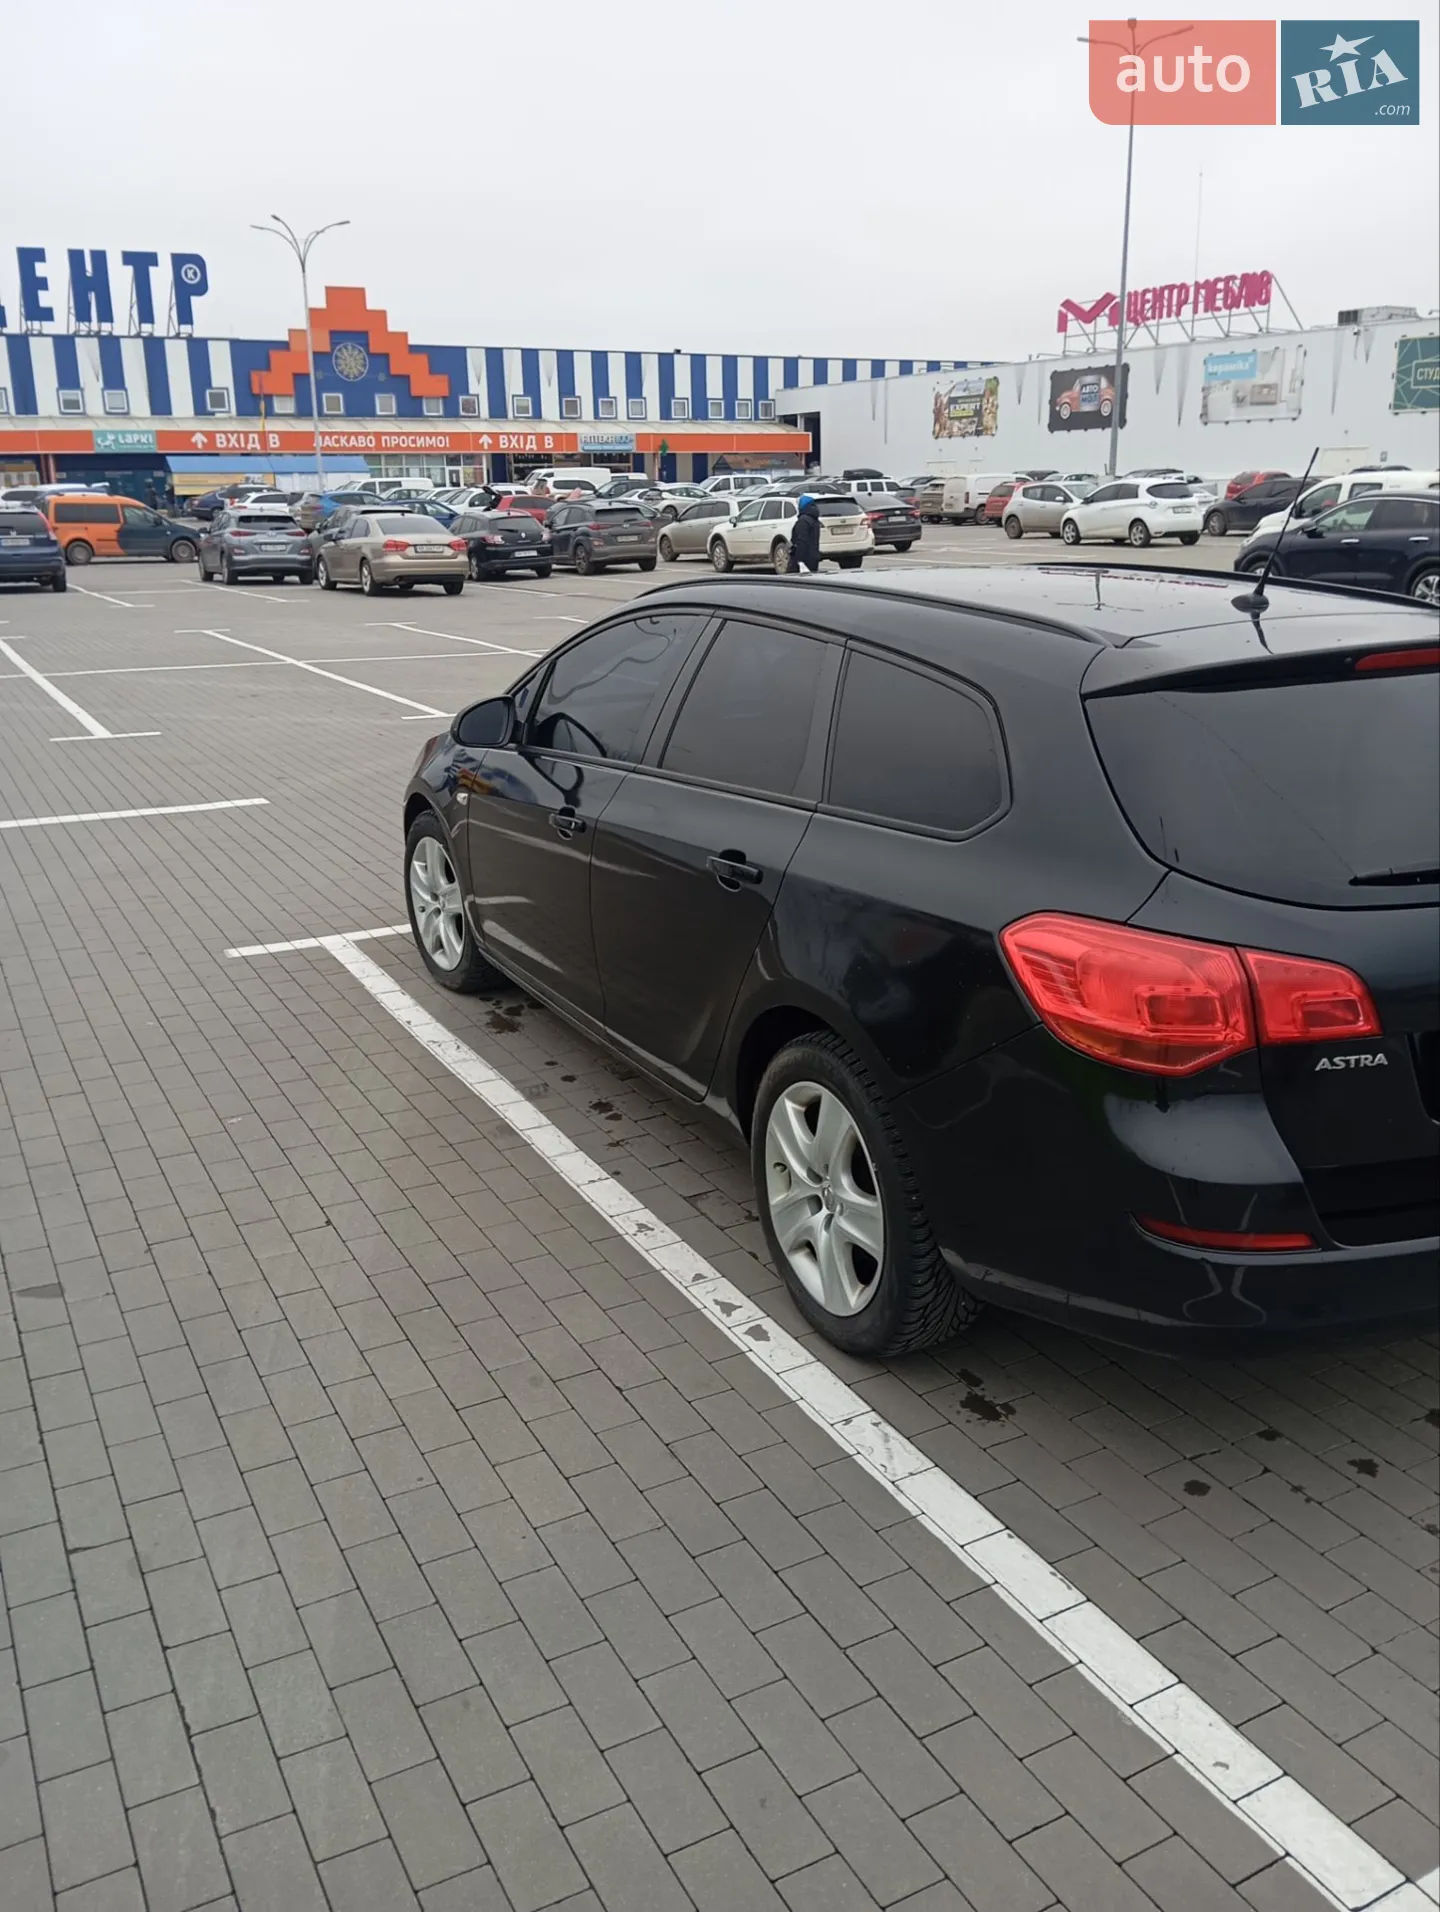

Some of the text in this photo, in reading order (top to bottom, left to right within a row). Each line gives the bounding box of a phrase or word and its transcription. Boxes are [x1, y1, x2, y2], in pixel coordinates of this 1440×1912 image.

[0, 247, 209, 328] ЕНТР
[1126, 282, 1190, 326] ЦЕНТР
[215, 433, 280, 450] ВХІД В
[381, 435, 450, 448] ПРОСИМО!
[499, 434, 554, 451] ВХІД В
[1315, 1053, 1388, 1071] ASTRA
